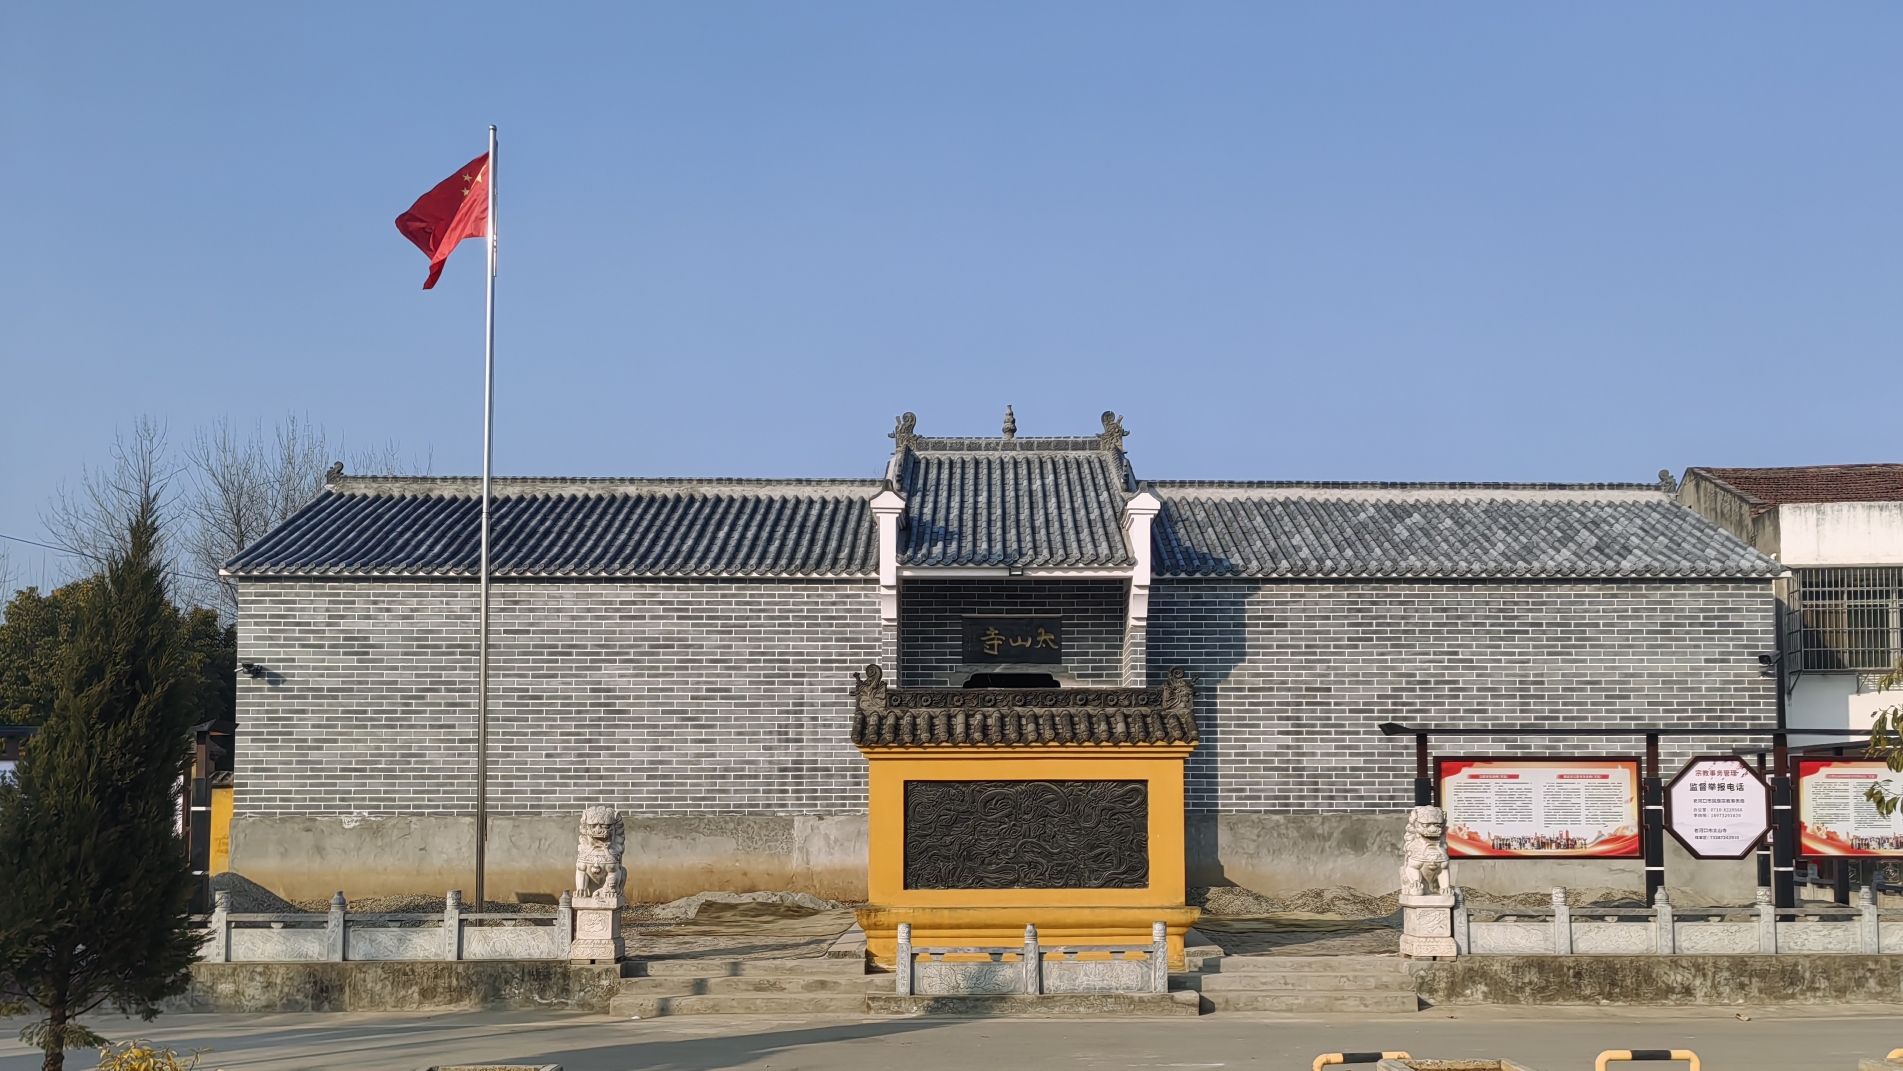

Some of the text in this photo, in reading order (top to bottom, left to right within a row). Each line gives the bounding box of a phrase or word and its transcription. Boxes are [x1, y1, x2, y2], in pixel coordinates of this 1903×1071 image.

[1695, 769, 1738, 777] 宗教事务管理
[1689, 782, 1745, 792] 监督举报电话
